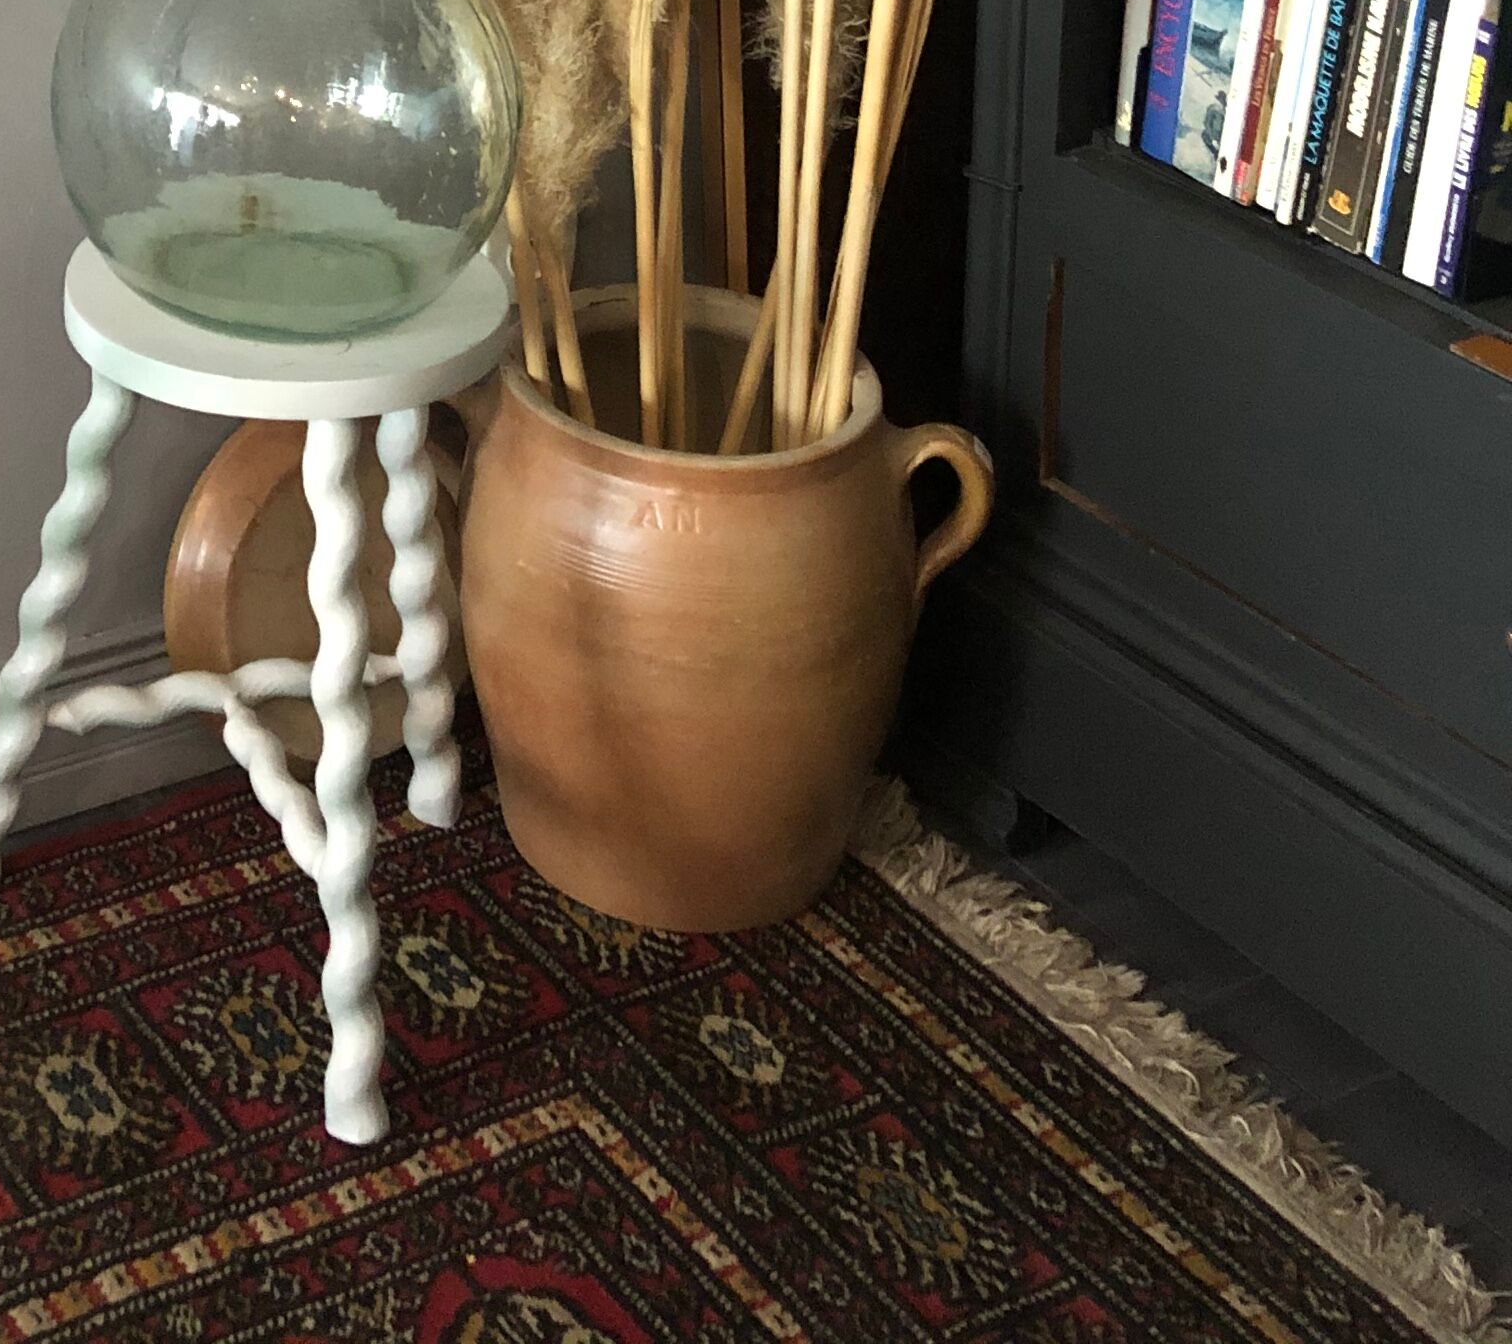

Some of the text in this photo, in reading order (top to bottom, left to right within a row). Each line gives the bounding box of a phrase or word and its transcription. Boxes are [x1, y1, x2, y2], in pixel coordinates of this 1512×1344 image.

[1326, 28, 1341, 51] DE
[1310, 49, 1337, 140] MAQUETTE
[1408, 118, 1421, 141] DES
[1421, 17, 1439, 62] MARINE
[1304, 140, 1320, 166] LA
